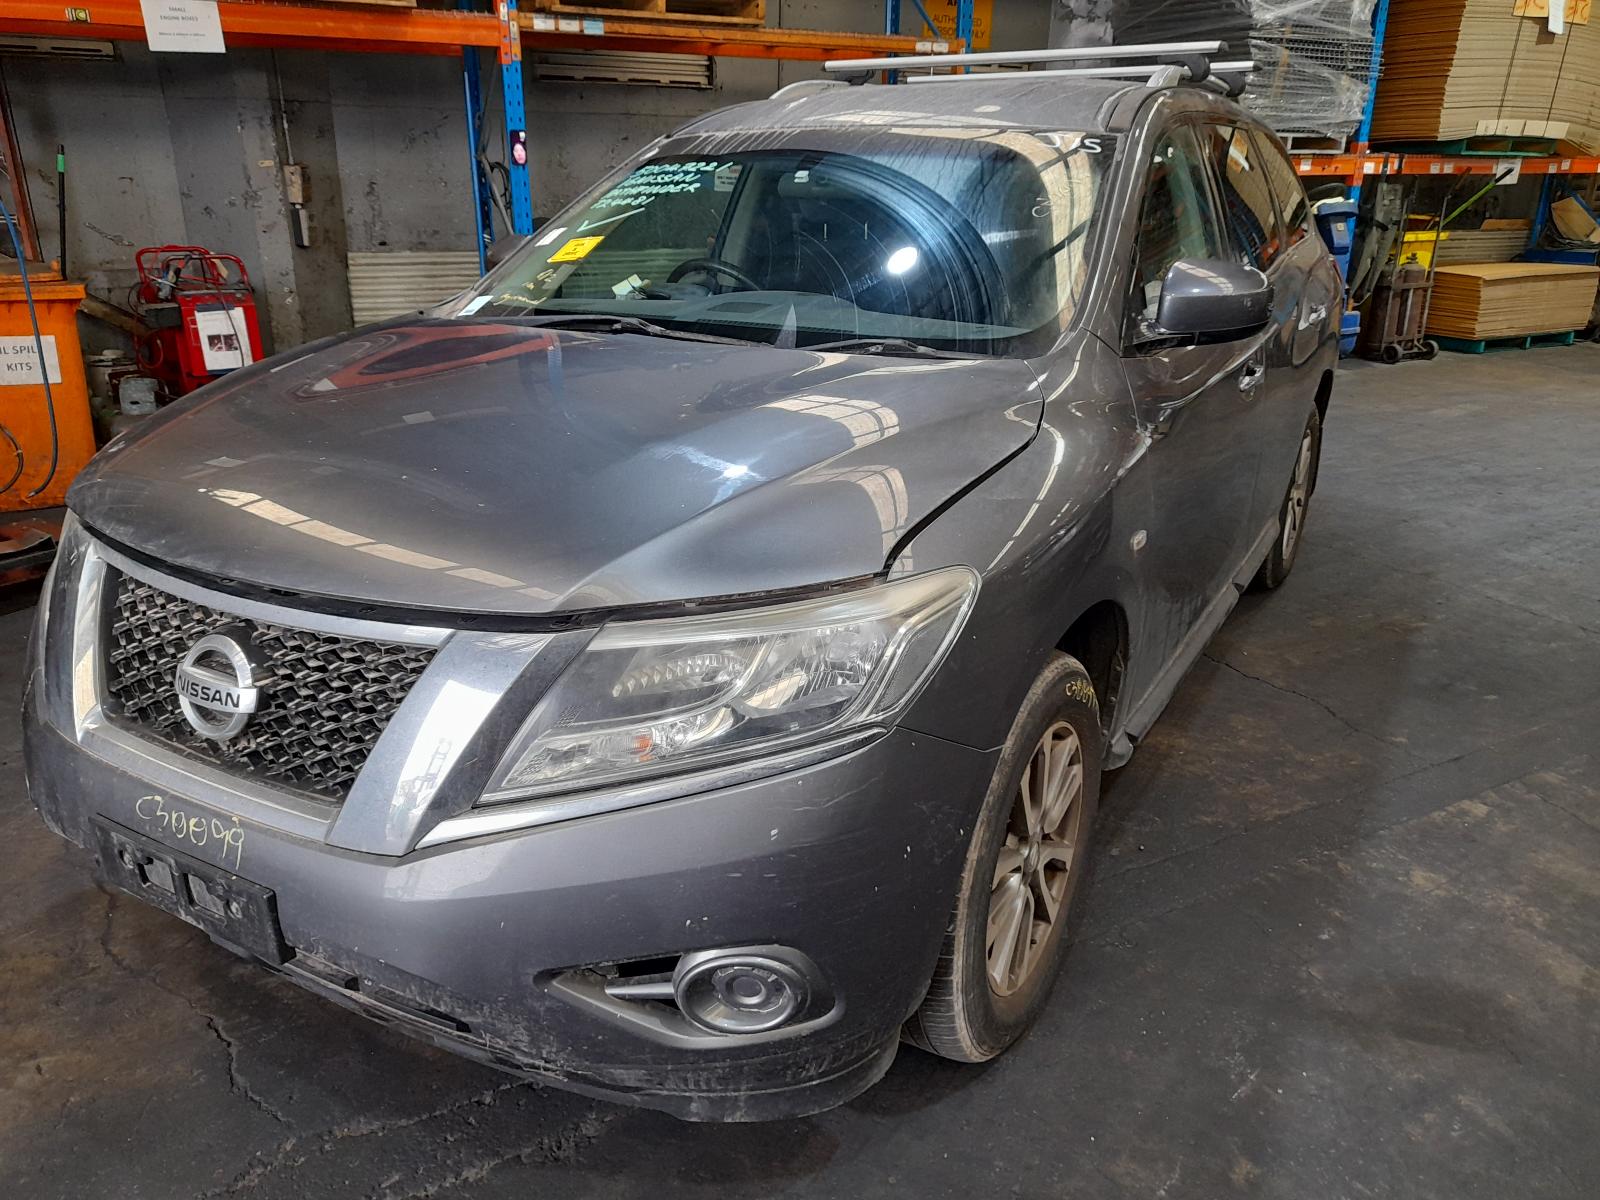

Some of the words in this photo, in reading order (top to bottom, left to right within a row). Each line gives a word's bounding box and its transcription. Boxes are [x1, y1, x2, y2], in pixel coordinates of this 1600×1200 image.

[12, 345, 38, 355] SPIL
[6, 362, 33, 372] KITS
[177, 673, 240, 708] NISSAN
